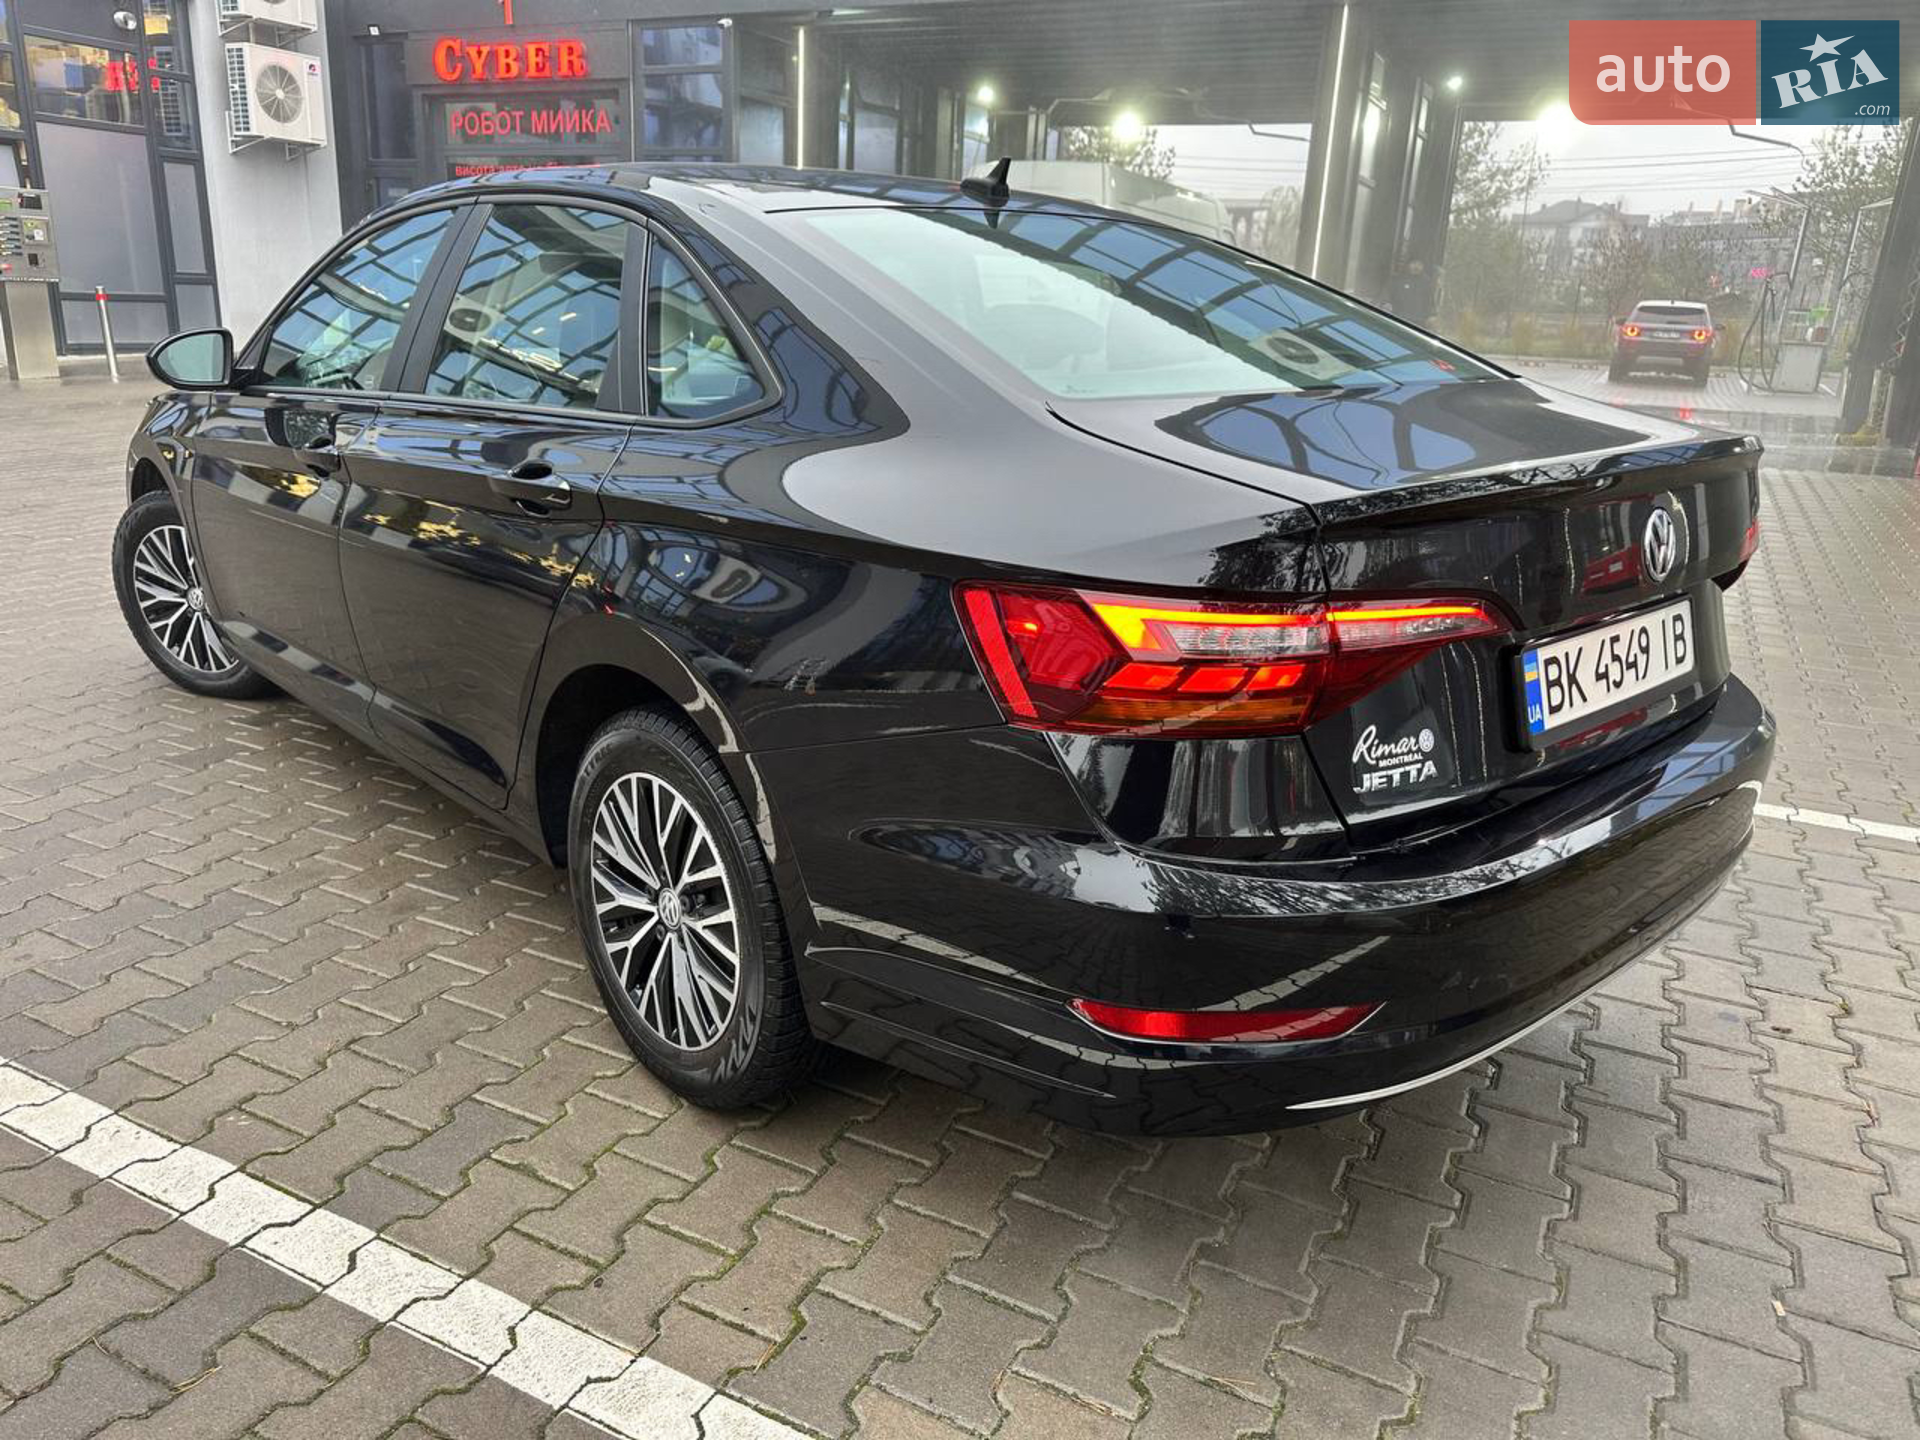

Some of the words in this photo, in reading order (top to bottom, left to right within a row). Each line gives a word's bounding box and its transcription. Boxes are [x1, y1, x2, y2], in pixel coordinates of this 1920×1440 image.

[452, 109, 525, 136] РОБОТ
[1543, 646, 1588, 715] BK
[1595, 625, 1650, 694] 4549
[1661, 612, 1687, 671] IB
[1527, 702, 1542, 724] UA
[1351, 724, 1418, 765] Rimar
[1378, 752, 1424, 768] MONTREAL
[1352, 760, 1439, 794] JETTA
